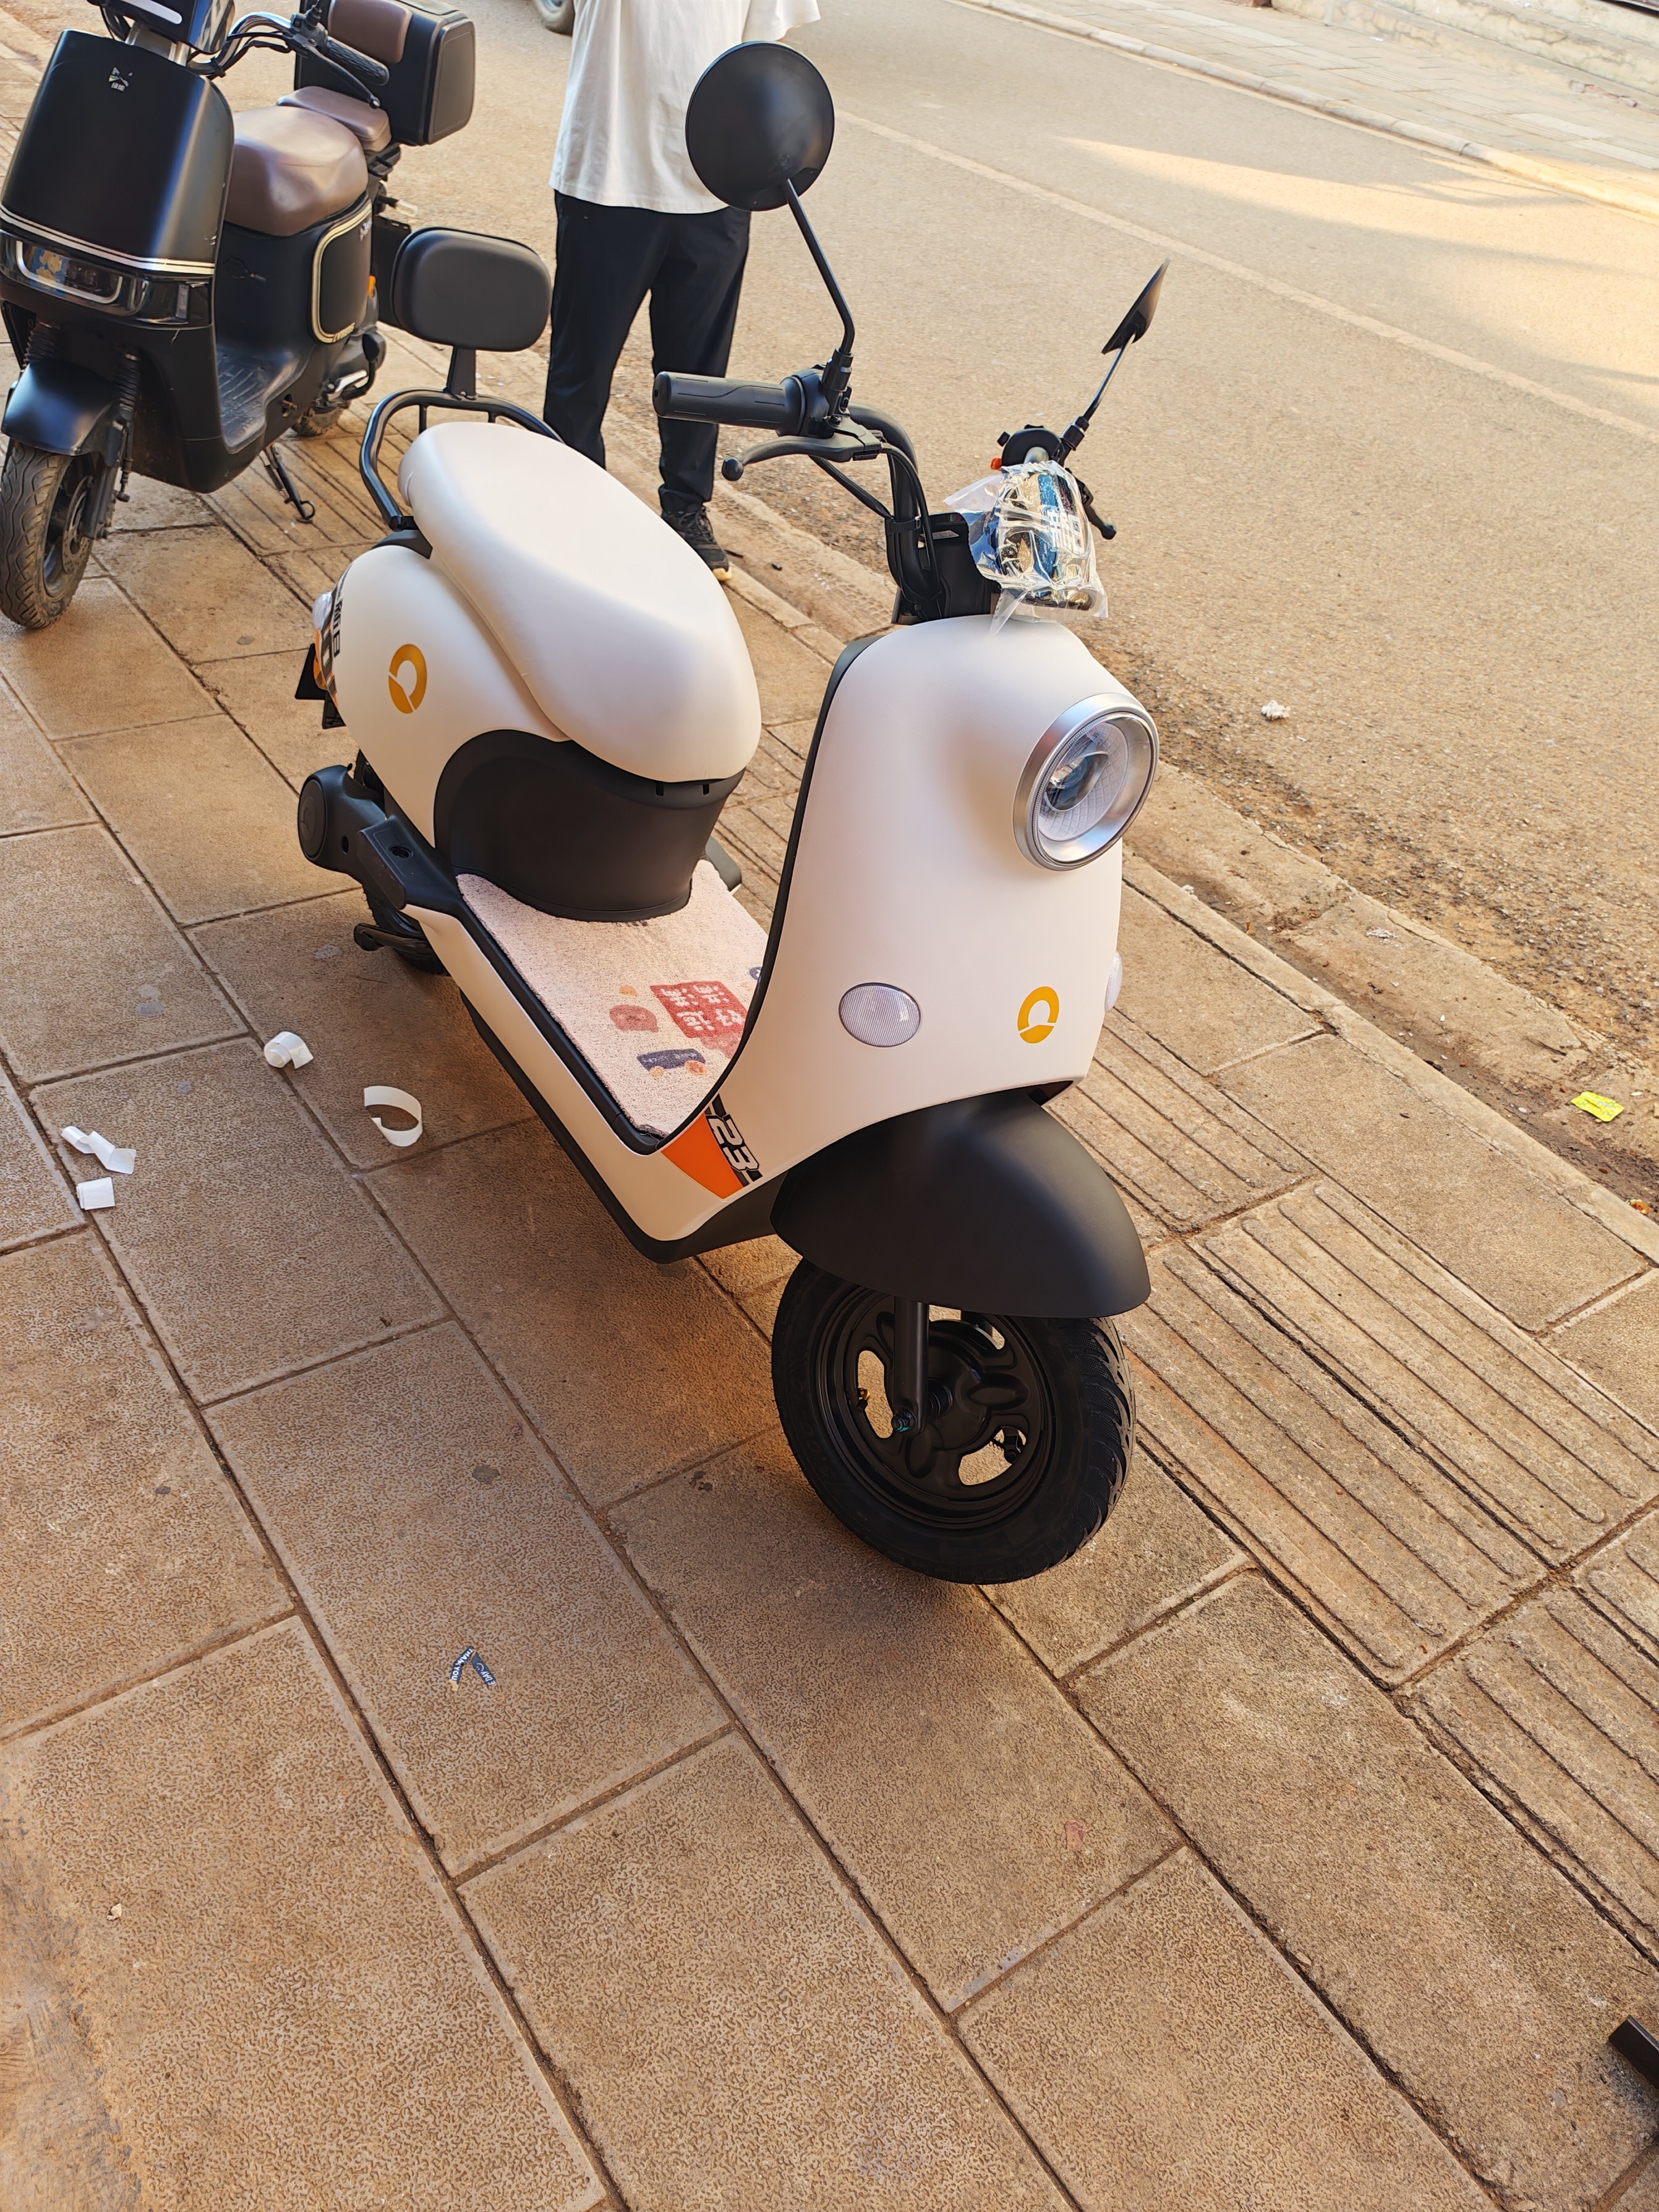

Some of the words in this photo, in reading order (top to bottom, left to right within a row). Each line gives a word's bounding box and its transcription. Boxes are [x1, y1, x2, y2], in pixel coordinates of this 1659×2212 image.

[333, 598, 343, 658] 新日
[676, 1008, 746, 1030] 好运
[705, 1115, 760, 1171] 23
[455, 1648, 474, 1666] THANK
[451, 1666, 461, 1681] YOU
[481, 1671, 494, 1682] DAY
